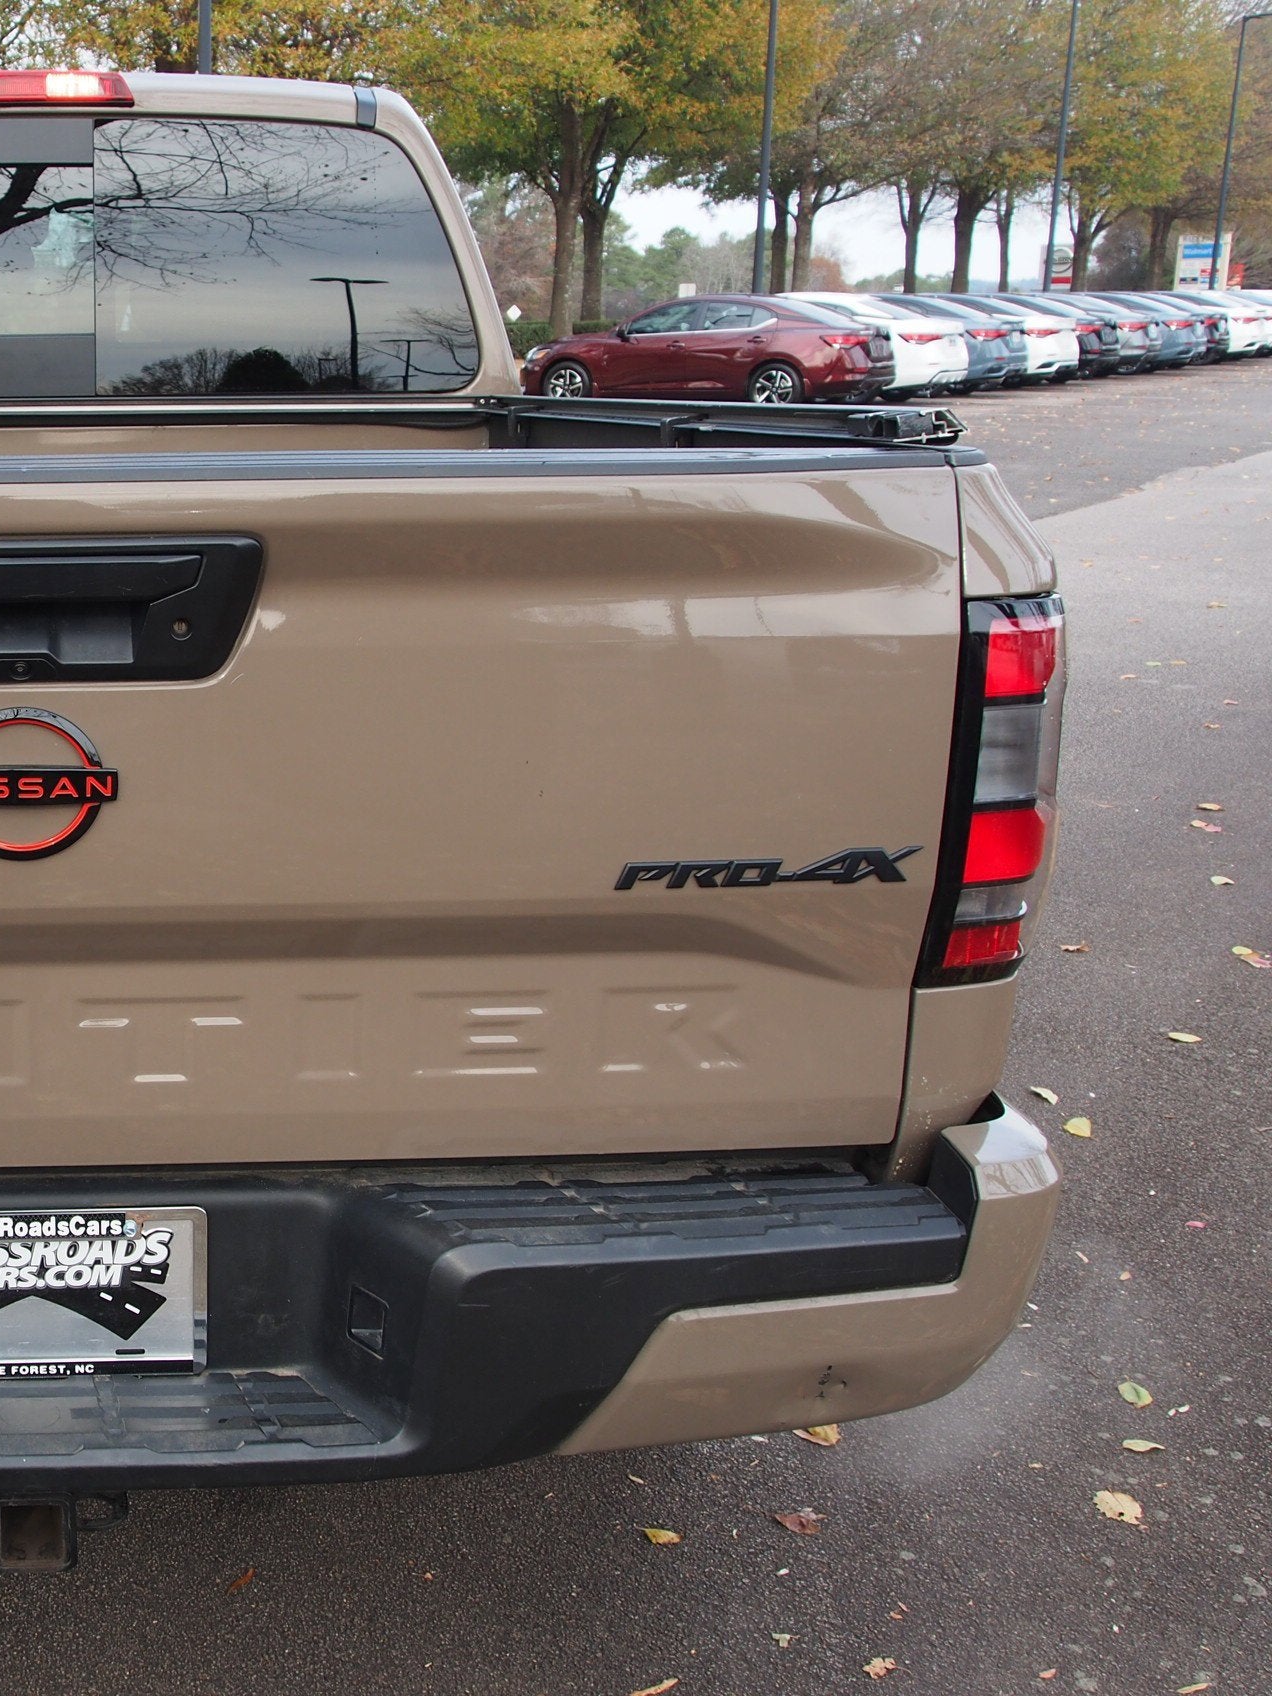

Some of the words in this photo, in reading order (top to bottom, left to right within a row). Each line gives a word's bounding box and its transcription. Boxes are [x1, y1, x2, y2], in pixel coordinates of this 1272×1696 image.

[614, 846, 924, 890] PRO-4X
[11, 1364, 70, 1375] FOREST,
[74, 1364, 95, 1374] NC
